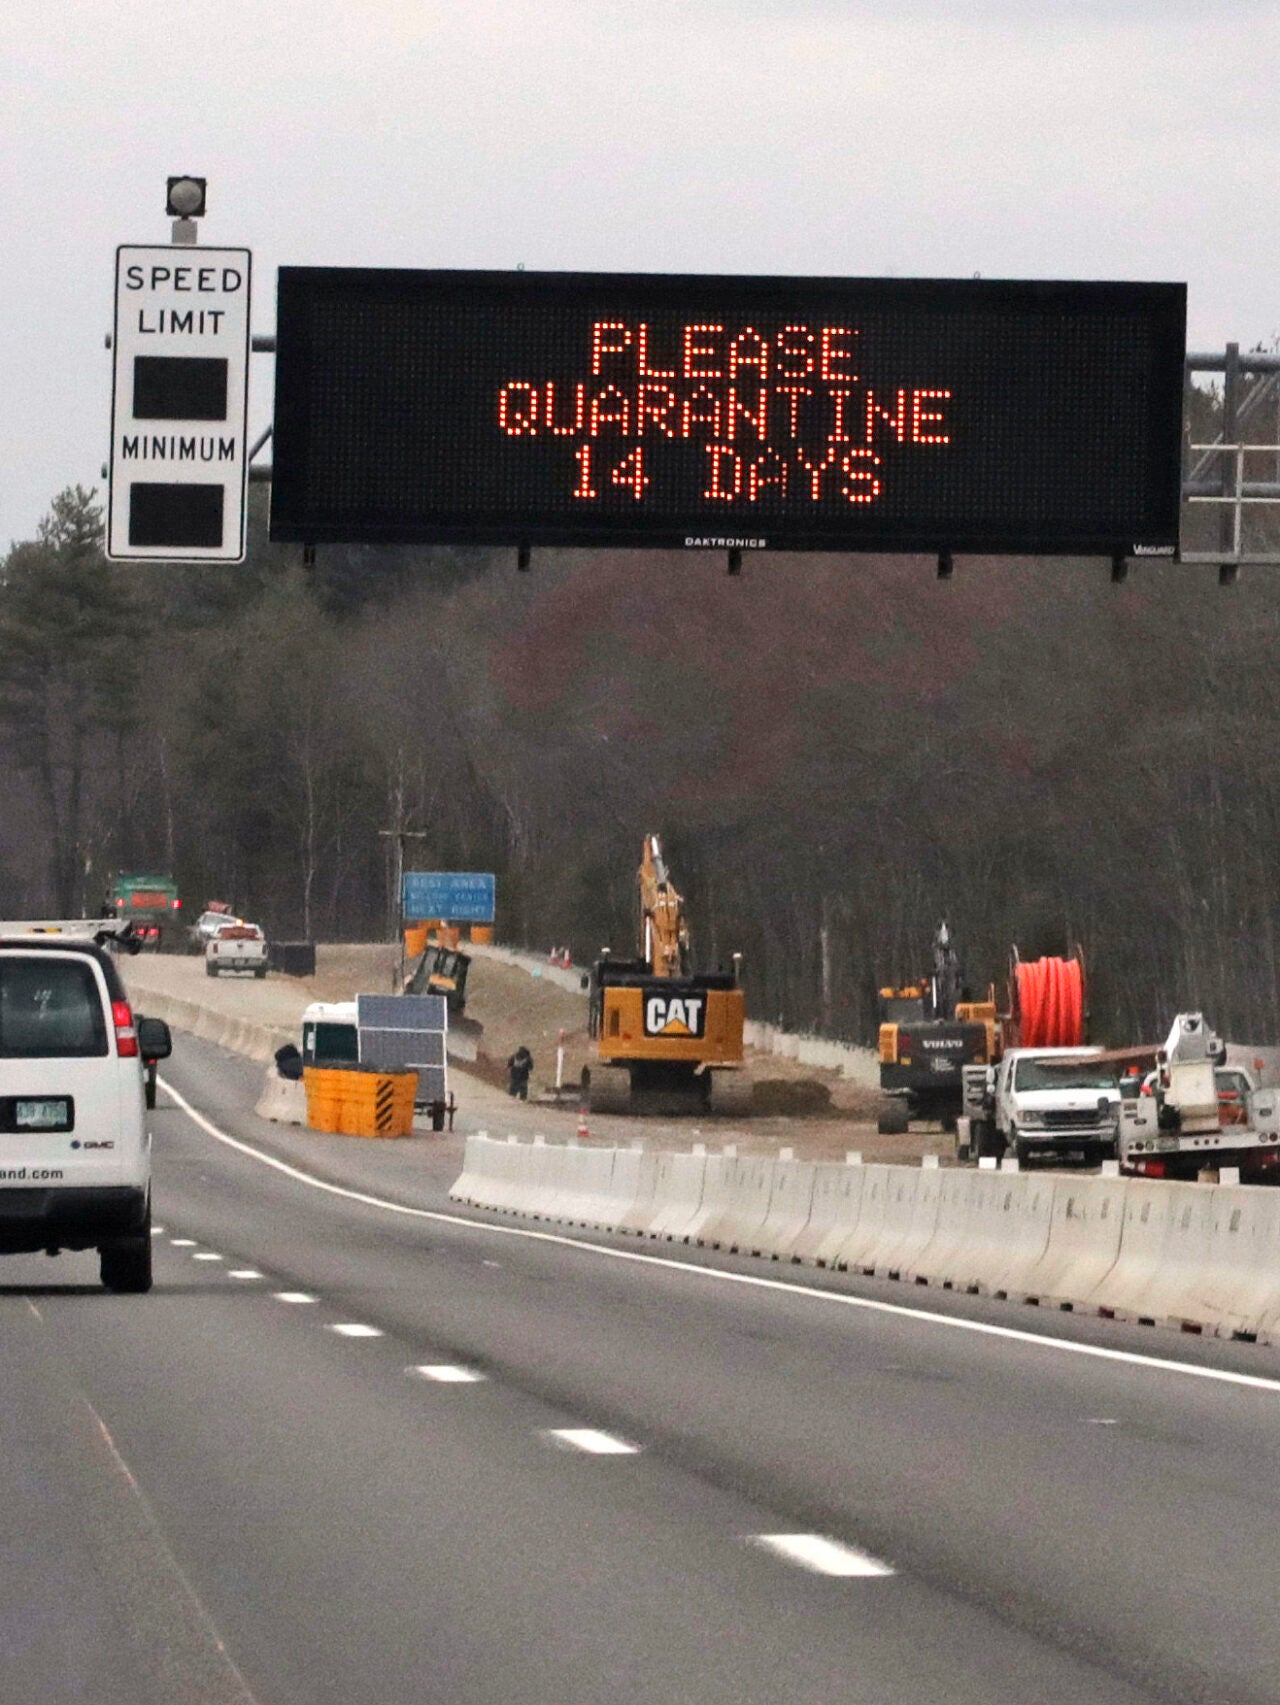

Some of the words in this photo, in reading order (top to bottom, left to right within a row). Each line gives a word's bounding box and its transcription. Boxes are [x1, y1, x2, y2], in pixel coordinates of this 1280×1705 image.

[126, 266, 242, 292] SPEED
[138, 309, 225, 335] LIMIT
[593, 322, 859, 380] PLEASE
[499, 382, 951, 443] QUARANTINE
[122, 436, 235, 461] MINIMUM
[574, 445, 649, 499] 14
[704, 445, 880, 502] DAYS
[684, 537, 766, 548] DAKTRONICS
[647, 998, 702, 1034] CAT
[922, 1040, 963, 1048] VOLVO
[83, 1141, 114, 1149] GMC
